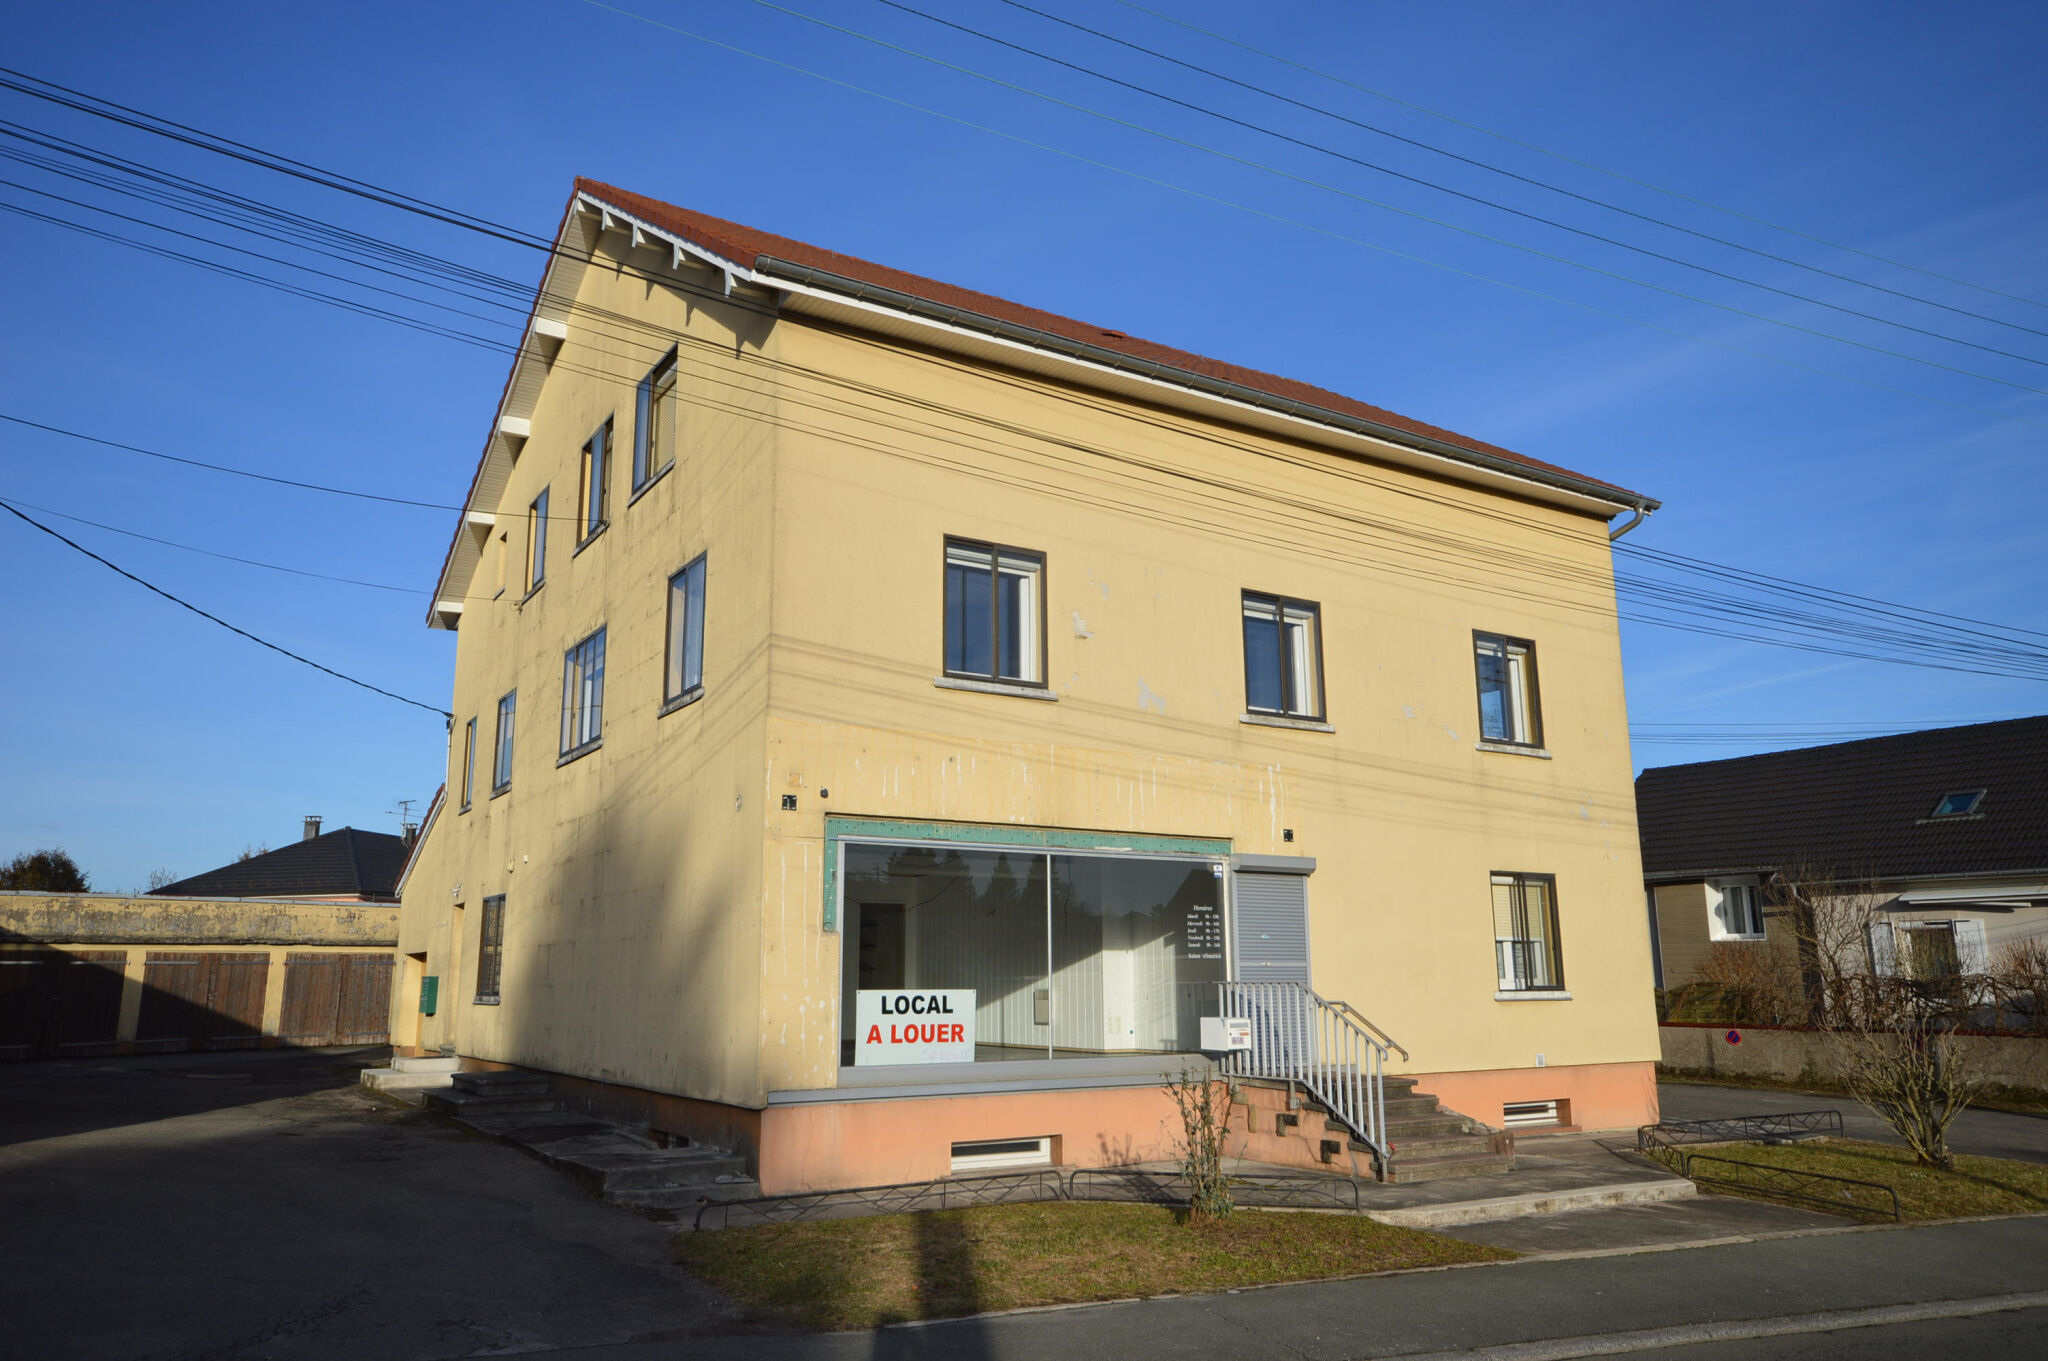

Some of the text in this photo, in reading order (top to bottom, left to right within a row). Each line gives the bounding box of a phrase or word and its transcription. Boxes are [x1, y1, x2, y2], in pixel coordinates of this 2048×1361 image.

[882, 995, 954, 1014] LOCAL
[866, 1024, 965, 1044] A LOUER
